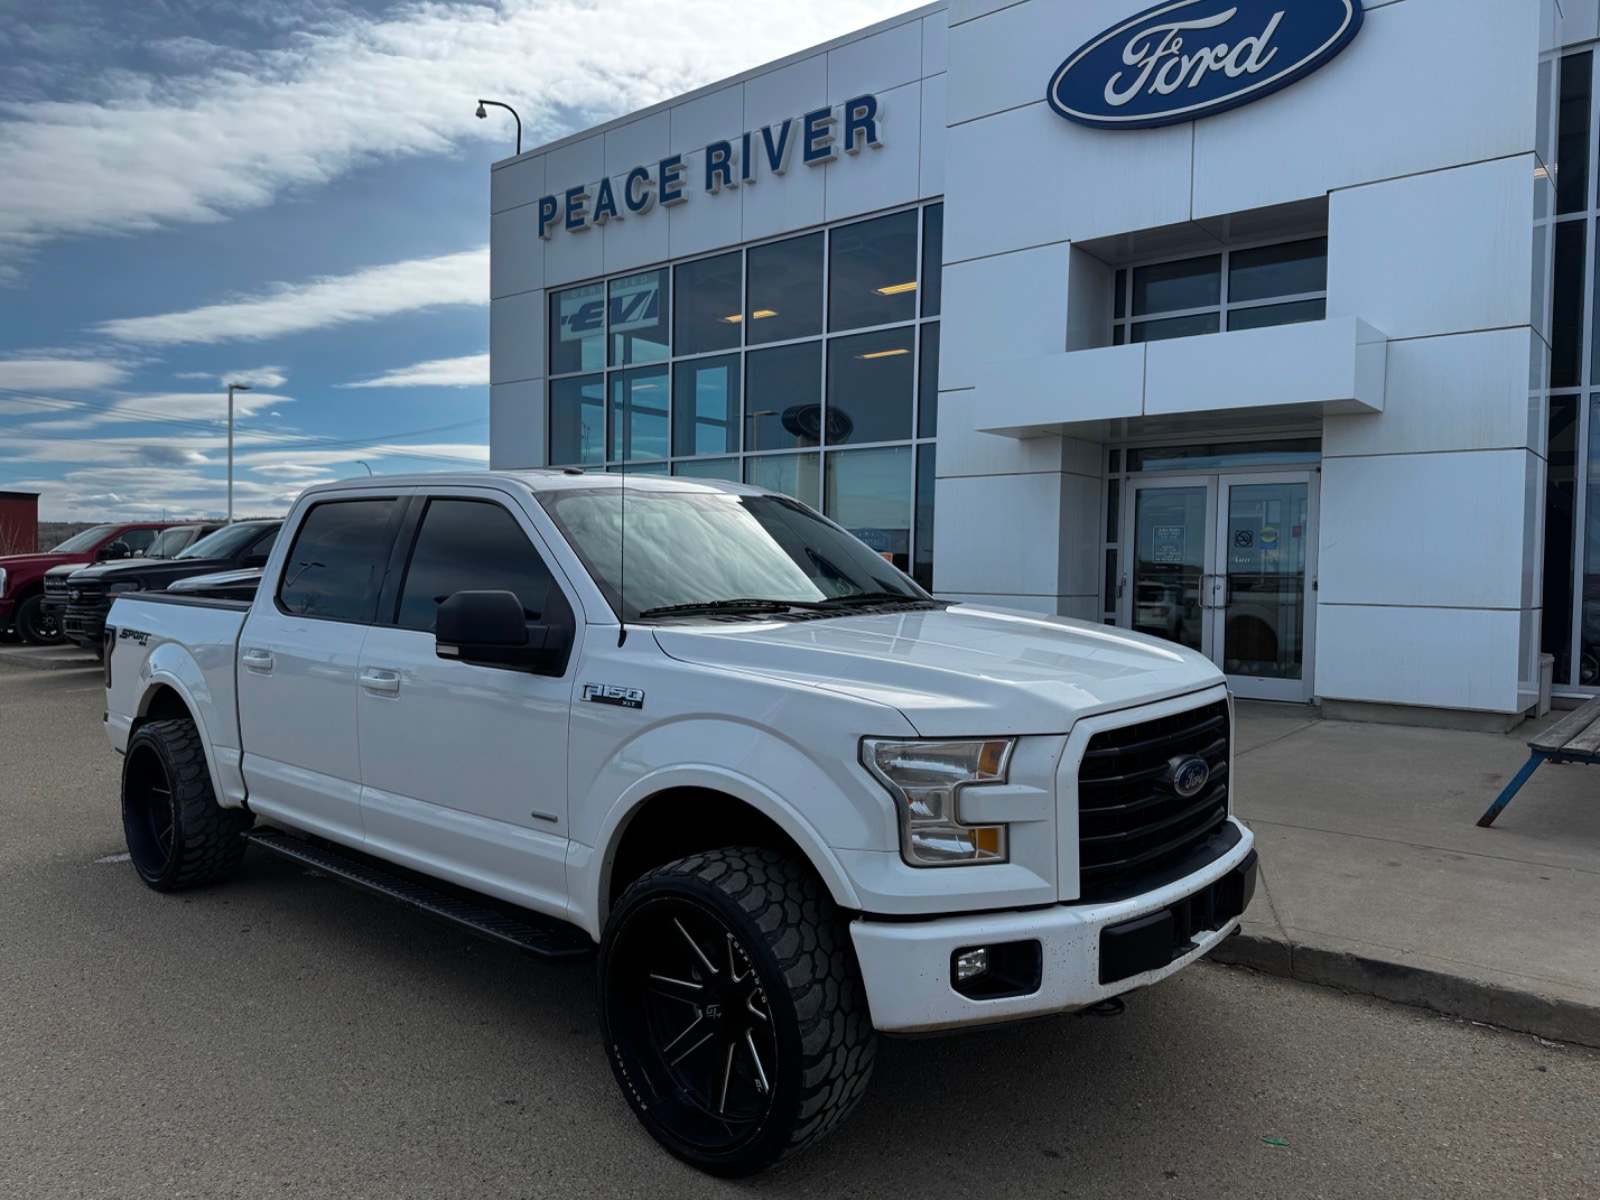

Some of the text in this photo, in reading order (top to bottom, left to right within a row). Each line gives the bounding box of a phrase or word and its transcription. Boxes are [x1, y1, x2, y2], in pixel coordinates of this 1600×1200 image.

[1104, 7, 1285, 106] Ford
[538, 94, 881, 240] PEACE RIVER
[119, 628, 152, 641] SPORT
